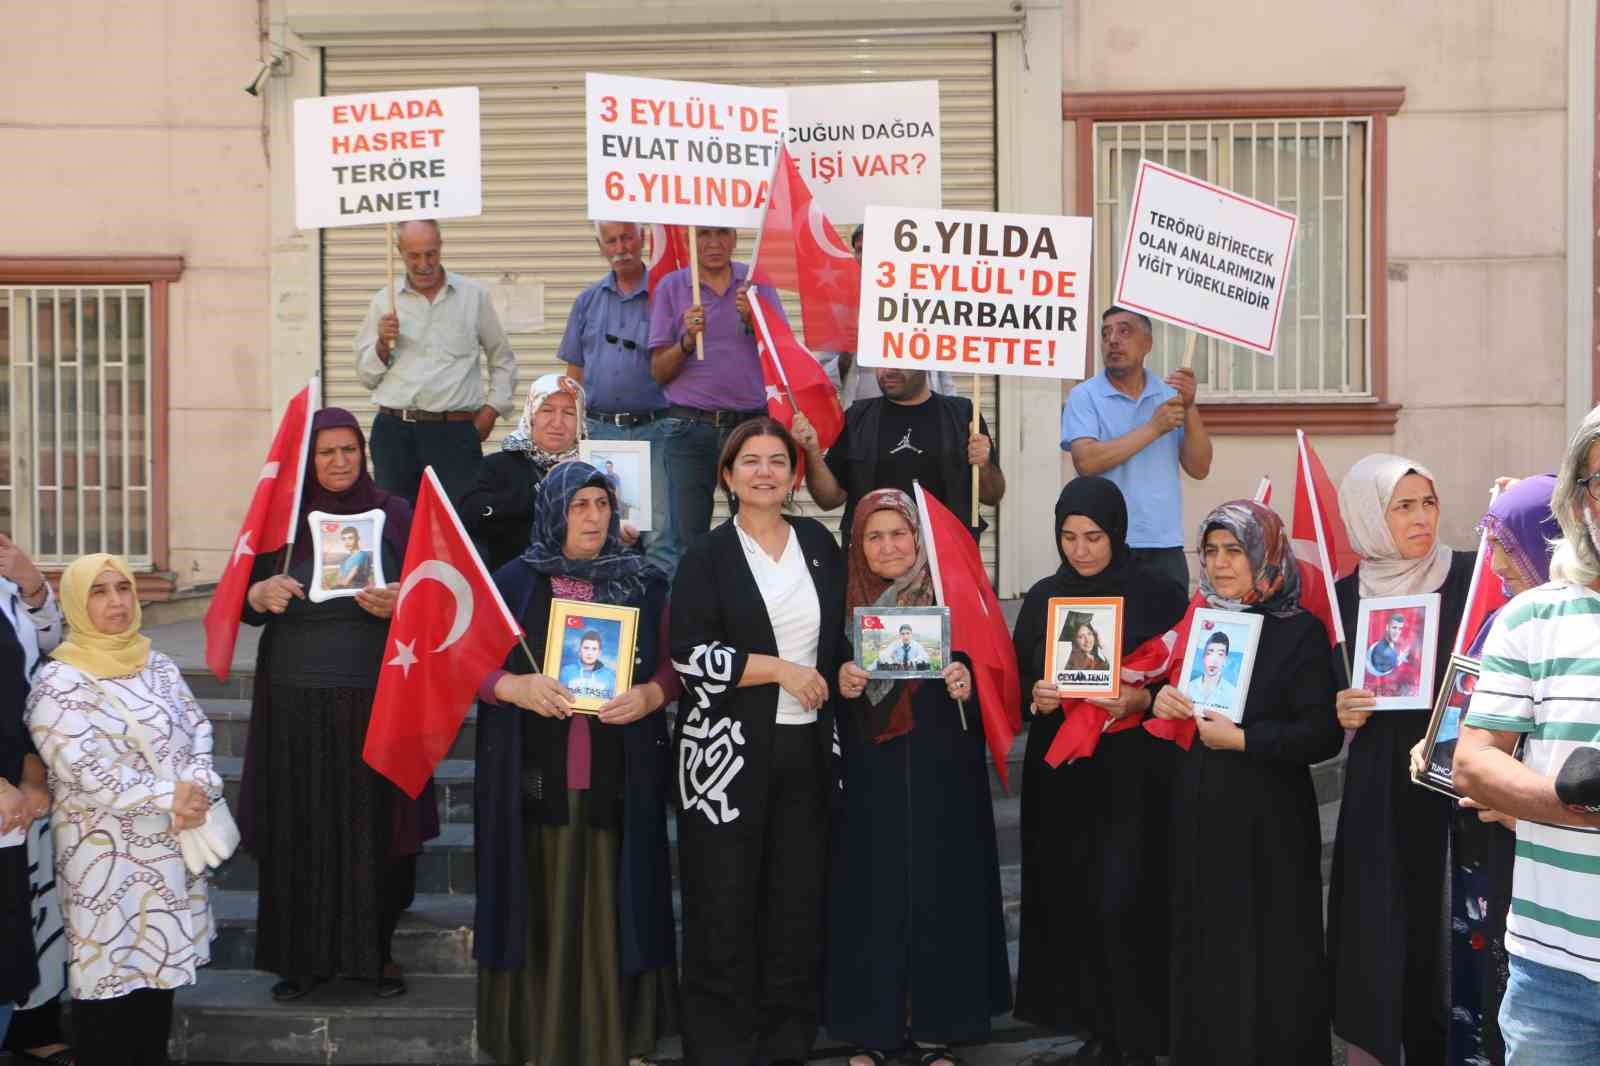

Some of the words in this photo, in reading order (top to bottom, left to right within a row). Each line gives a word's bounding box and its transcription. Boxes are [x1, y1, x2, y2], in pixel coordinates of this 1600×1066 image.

[332, 99, 444, 125] EVLADA
[600, 96, 618, 123] 3
[631, 97, 779, 134] EYLÜL'DE
[862, 119, 935, 140] DAĞDA
[331, 129, 445, 154] HASRET
[602, 134, 679, 161] EVLAT
[332, 158, 445, 184] TERÖRE
[811, 150, 844, 183] İŞİ
[853, 152, 927, 177] VAR?
[340, 190, 440, 215] LANET!
[604, 171, 777, 210] 6.YILINDA
[894, 219, 1058, 260] 6.YILDA
[1150, 210, 1205, 241] TERÖRÜ
[1207, 231, 1274, 267] BİTİRECEK
[875, 261, 897, 288] 3
[909, 260, 1077, 298] EYLÜL'DE
[1139, 231, 1178, 256] OLAN
[1180, 246, 1276, 289] ANALARIMIZIN
[1138, 253, 1174, 277] YİĞİT
[1177, 265, 1271, 310] YÜREKLERİDİR
[877, 292, 1078, 332] DİYARBAKIR
[882, 327, 1057, 367] NÖBETTE!
